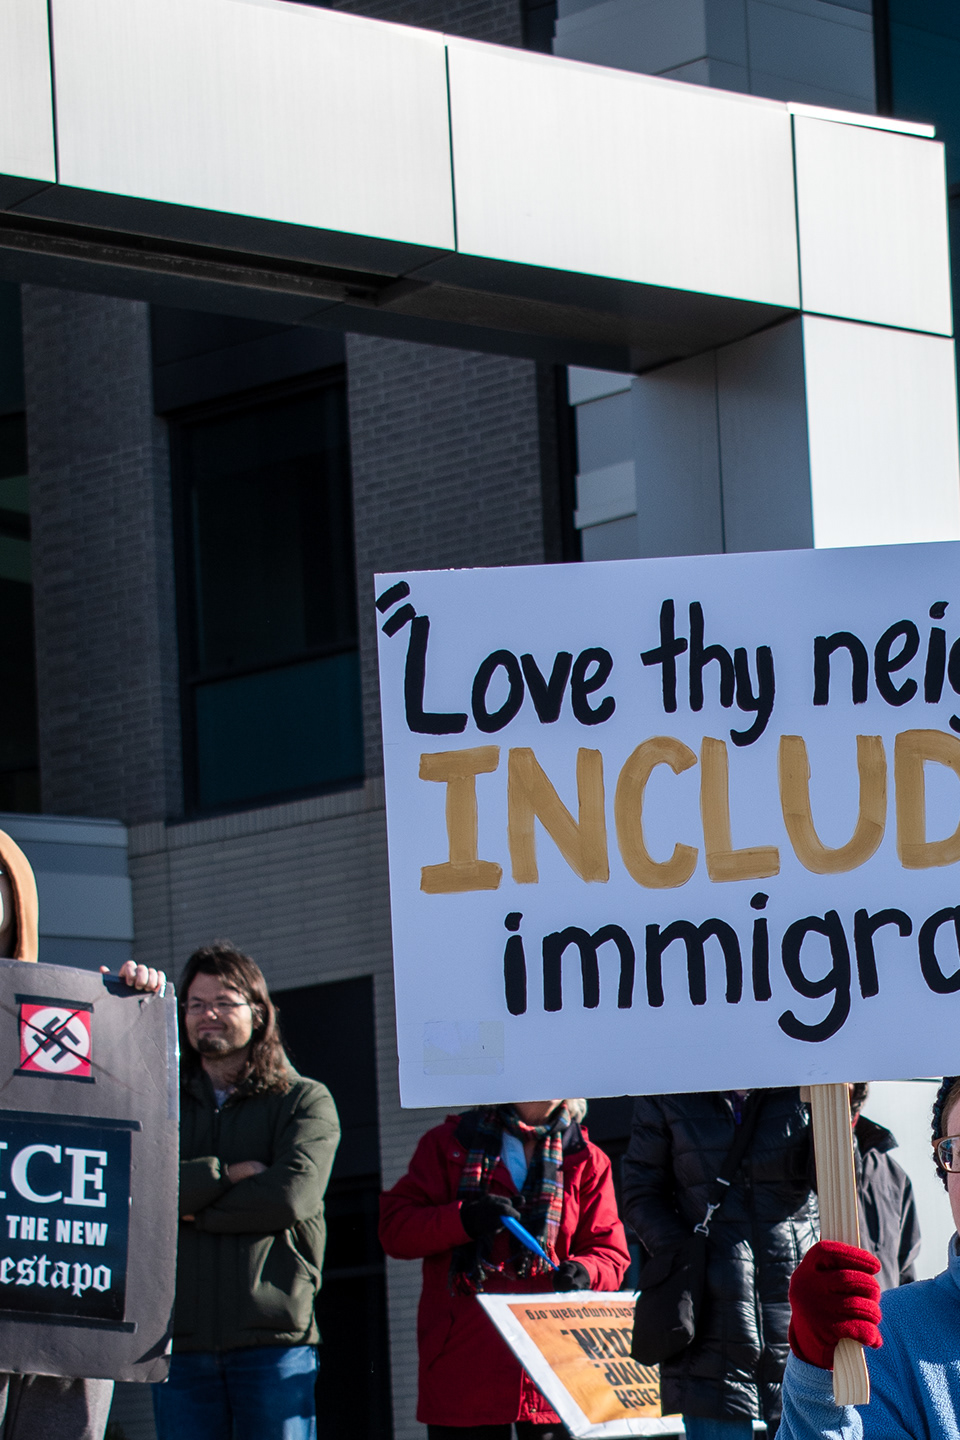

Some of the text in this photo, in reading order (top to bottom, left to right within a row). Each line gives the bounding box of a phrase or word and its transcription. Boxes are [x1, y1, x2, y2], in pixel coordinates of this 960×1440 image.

[641, 599, 776, 747] thy
[6, 1215, 108, 1246] THE NEW
[0, 1254, 112, 1298] estapo
